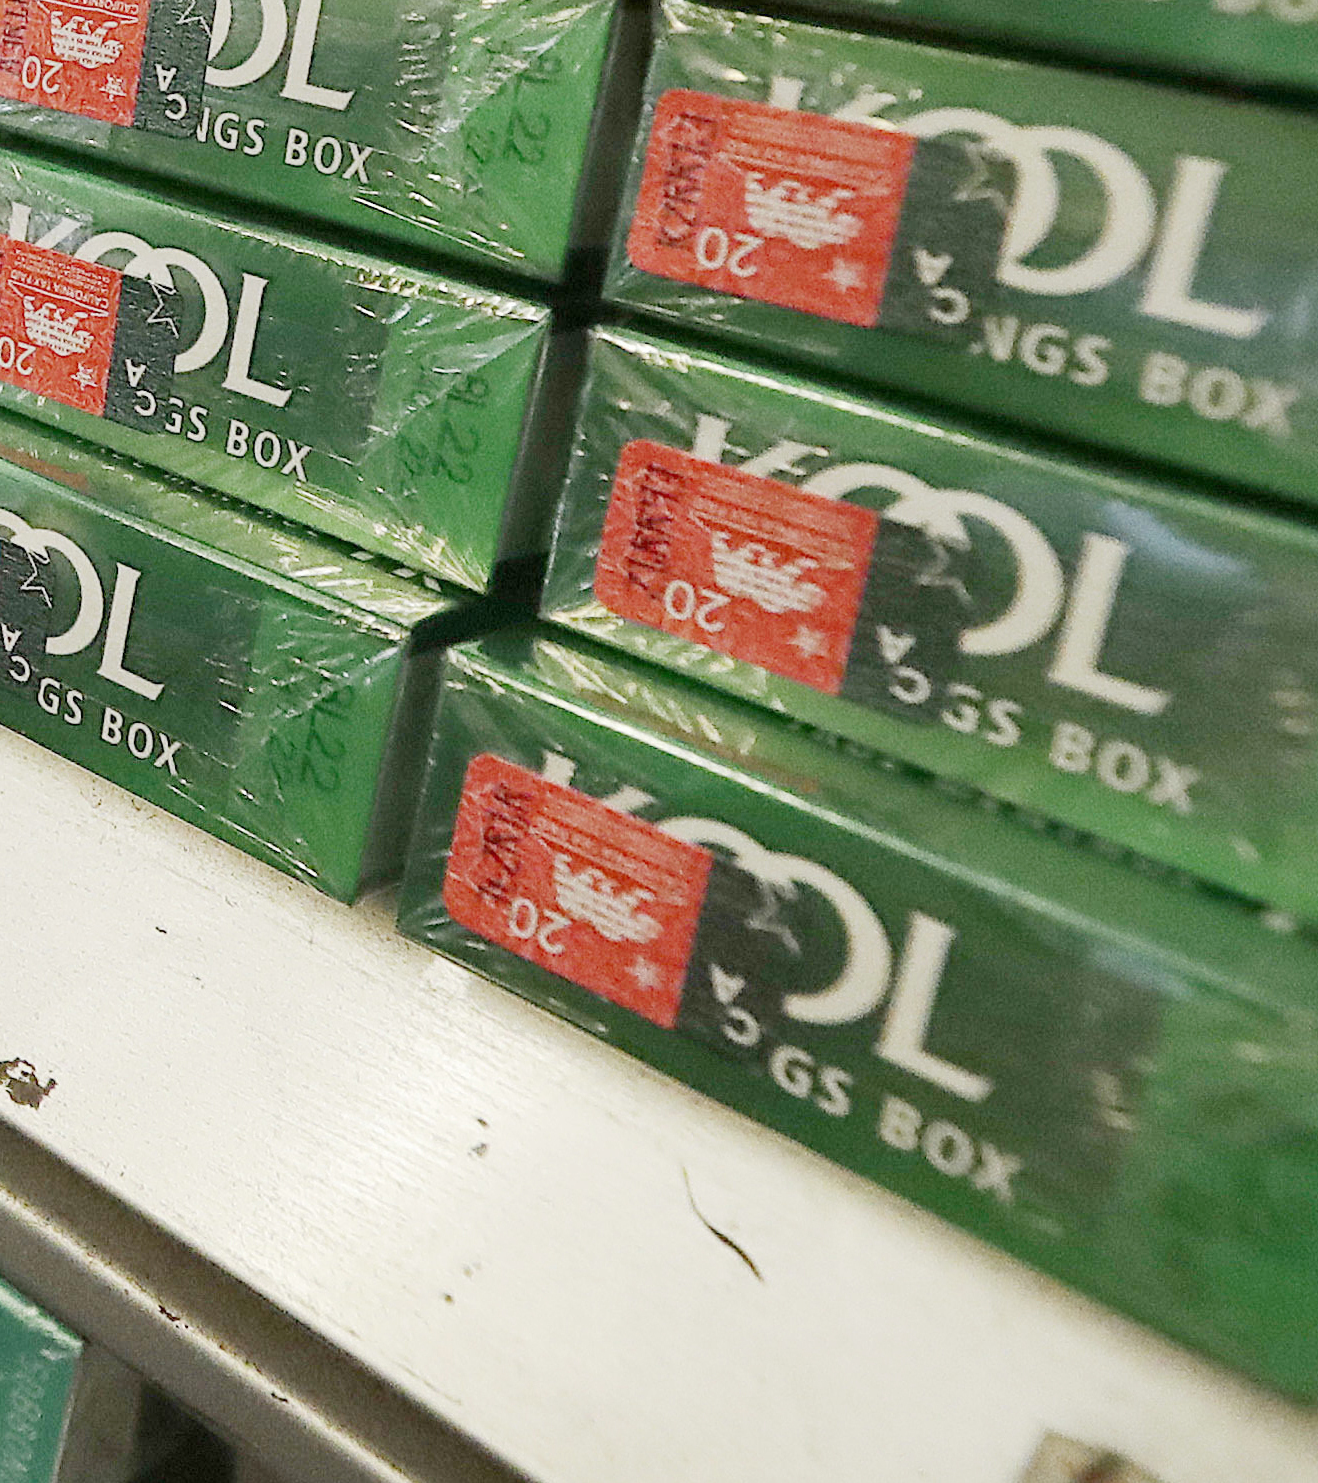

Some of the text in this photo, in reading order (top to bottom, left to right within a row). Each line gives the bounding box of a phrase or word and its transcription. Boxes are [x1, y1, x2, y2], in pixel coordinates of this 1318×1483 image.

[21, 56, 63, 94] 20
[284, 123, 376, 186] BOX
[696, 224, 764, 278] 20
[31, 276, 52, 293] TAX
[53, 282, 110, 308] CALIFORNIA
[1138, 350, 1300, 437] BOX
[225, 418, 313, 483] BOX
[663, 577, 727, 634] 20
[99, 704, 183, 778] BOX
[1048, 719, 1201, 814] BOX
[507, 896, 575, 956] 20
[876, 1095, 1022, 1204] BOX
